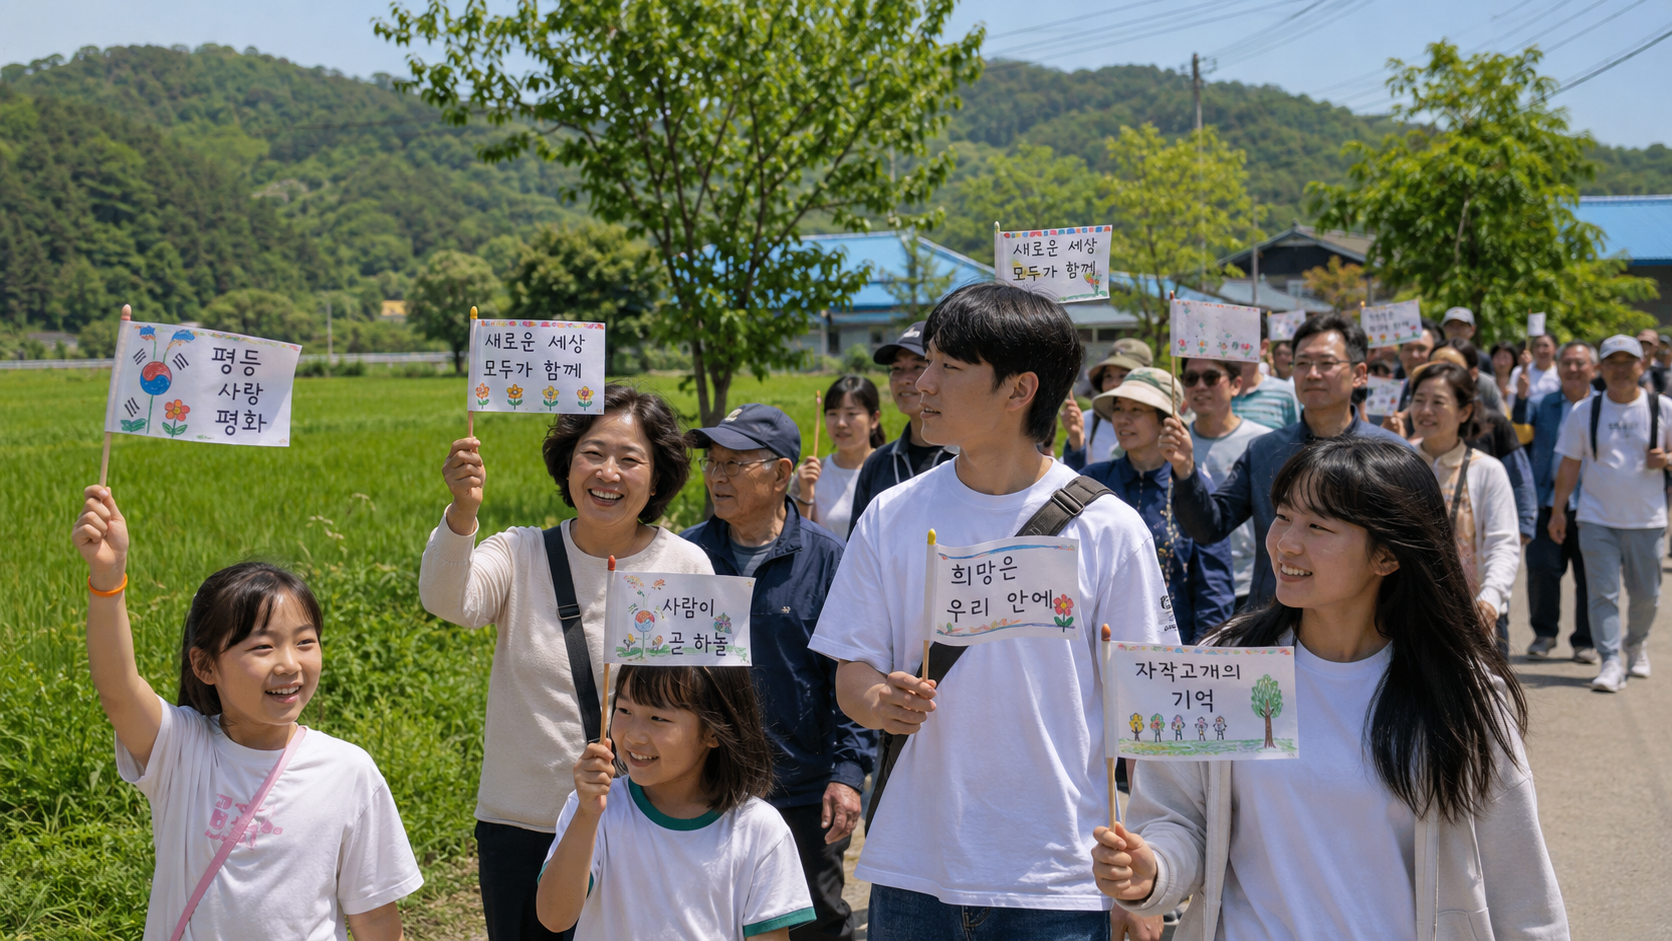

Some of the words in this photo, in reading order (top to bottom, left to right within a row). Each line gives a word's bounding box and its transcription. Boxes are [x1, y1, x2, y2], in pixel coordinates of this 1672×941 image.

[1013, 239, 1059, 257] 새로운
[1068, 237, 1098, 255] 세상
[1012, 265, 1058, 282] 모두가
[1065, 260, 1096, 280] 함께
[484, 331, 536, 353] 새로운
[548, 334, 586, 354] 세상
[211, 347, 261, 377] 평등
[483, 359, 533, 380] 모두가
[543, 359, 582, 381] 함께
[218, 382, 264, 406] 사랑
[215, 409, 267, 436] 평화
[951, 555, 1018, 586] 희망은
[662, 596, 714, 619] 사람이
[946, 597, 989, 623] 우리
[1007, 589, 1053, 614] 안에
[1135, 660, 1241, 683] 자작고개의
[1171, 688, 1214, 713] 기억
